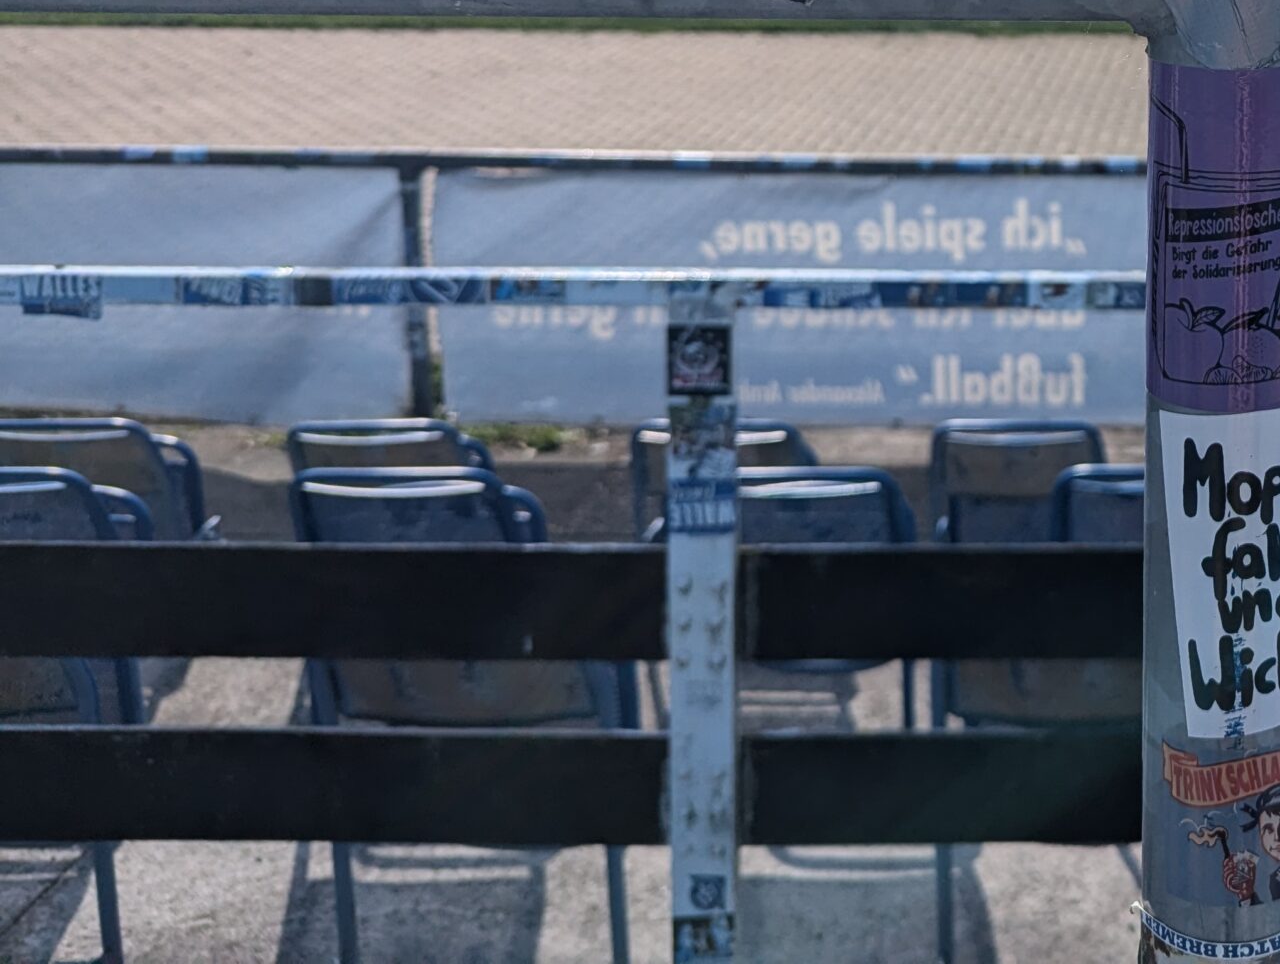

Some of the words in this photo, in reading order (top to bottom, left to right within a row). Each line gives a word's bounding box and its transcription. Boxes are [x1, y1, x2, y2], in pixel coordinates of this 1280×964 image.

[1172, 246, 1196, 264] Birgt
[1202, 245, 1219, 260] die
[1226, 238, 1272, 257] Gefahr
[1172, 265, 1187, 279] der
